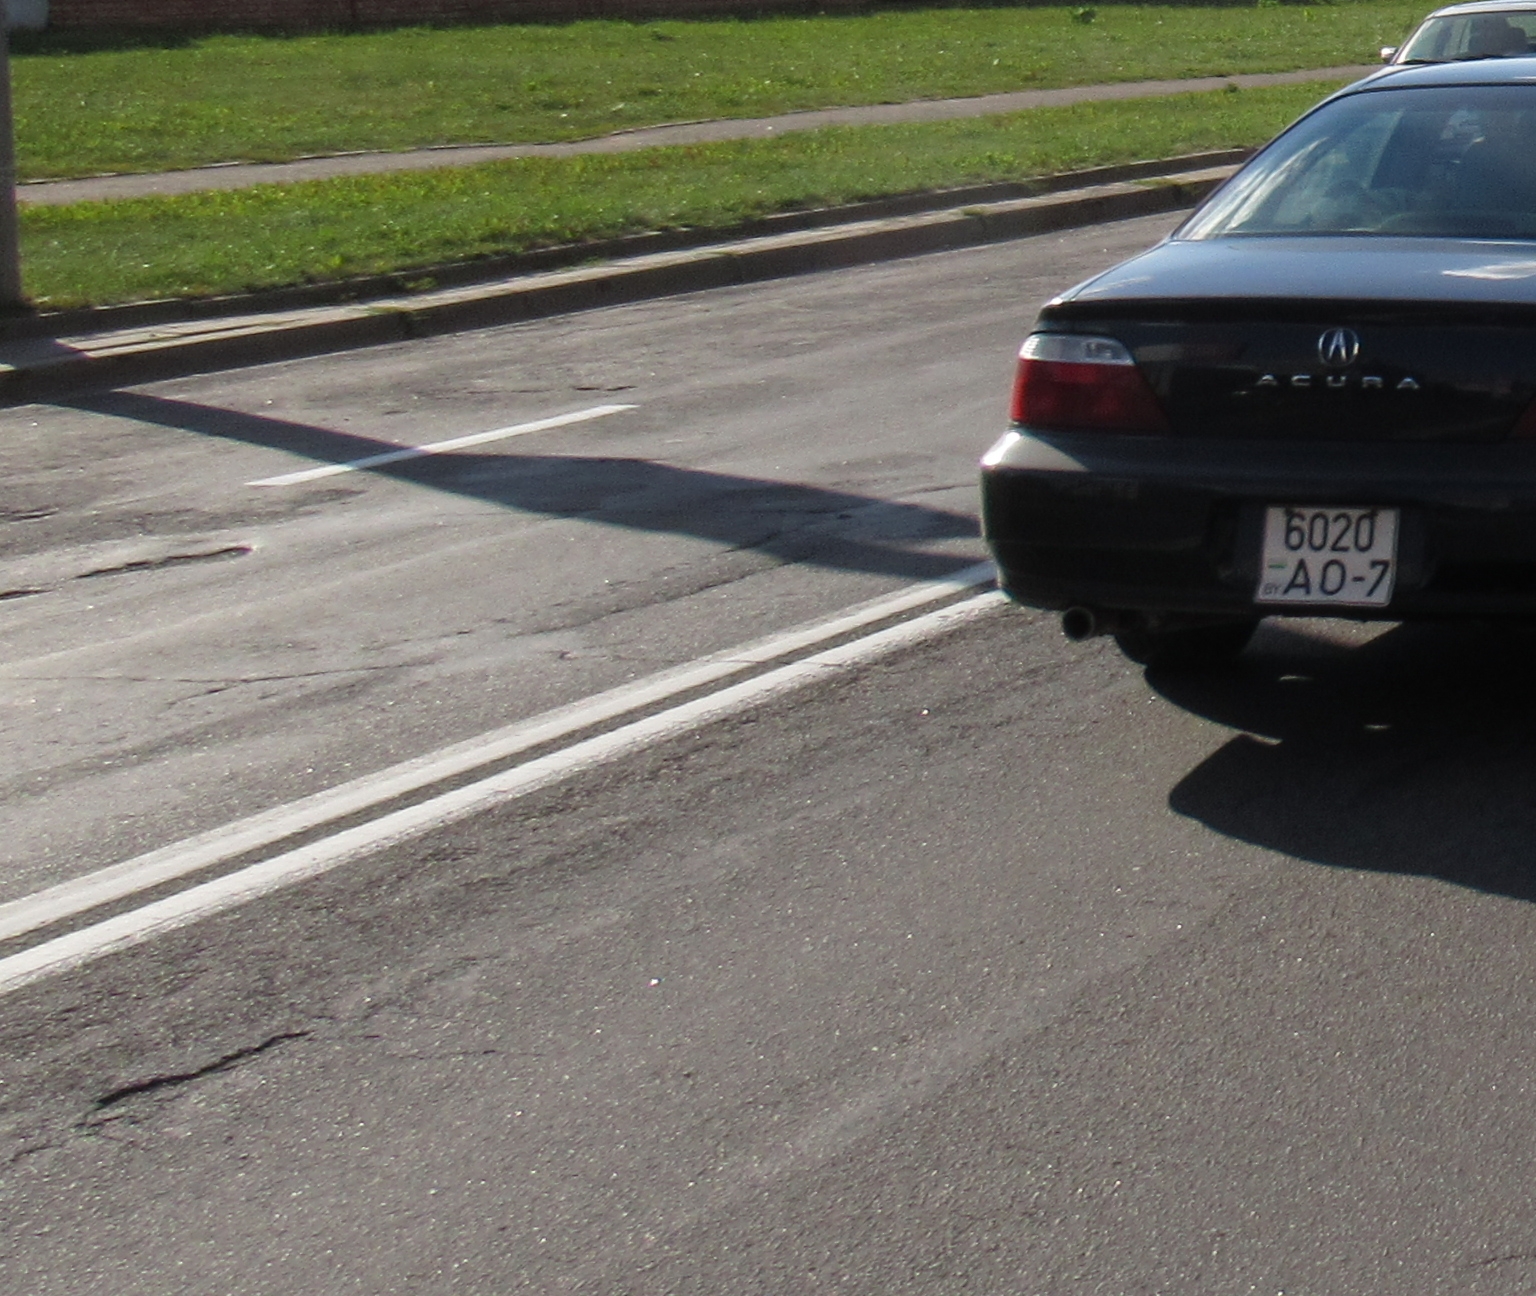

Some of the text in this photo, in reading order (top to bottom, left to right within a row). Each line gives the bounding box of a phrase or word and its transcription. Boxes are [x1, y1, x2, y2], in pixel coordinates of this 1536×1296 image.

[1256, 374, 1421, 390] ACURA
[1284, 512, 1377, 553] 6020
[1283, 558, 1391, 598] AO-7
